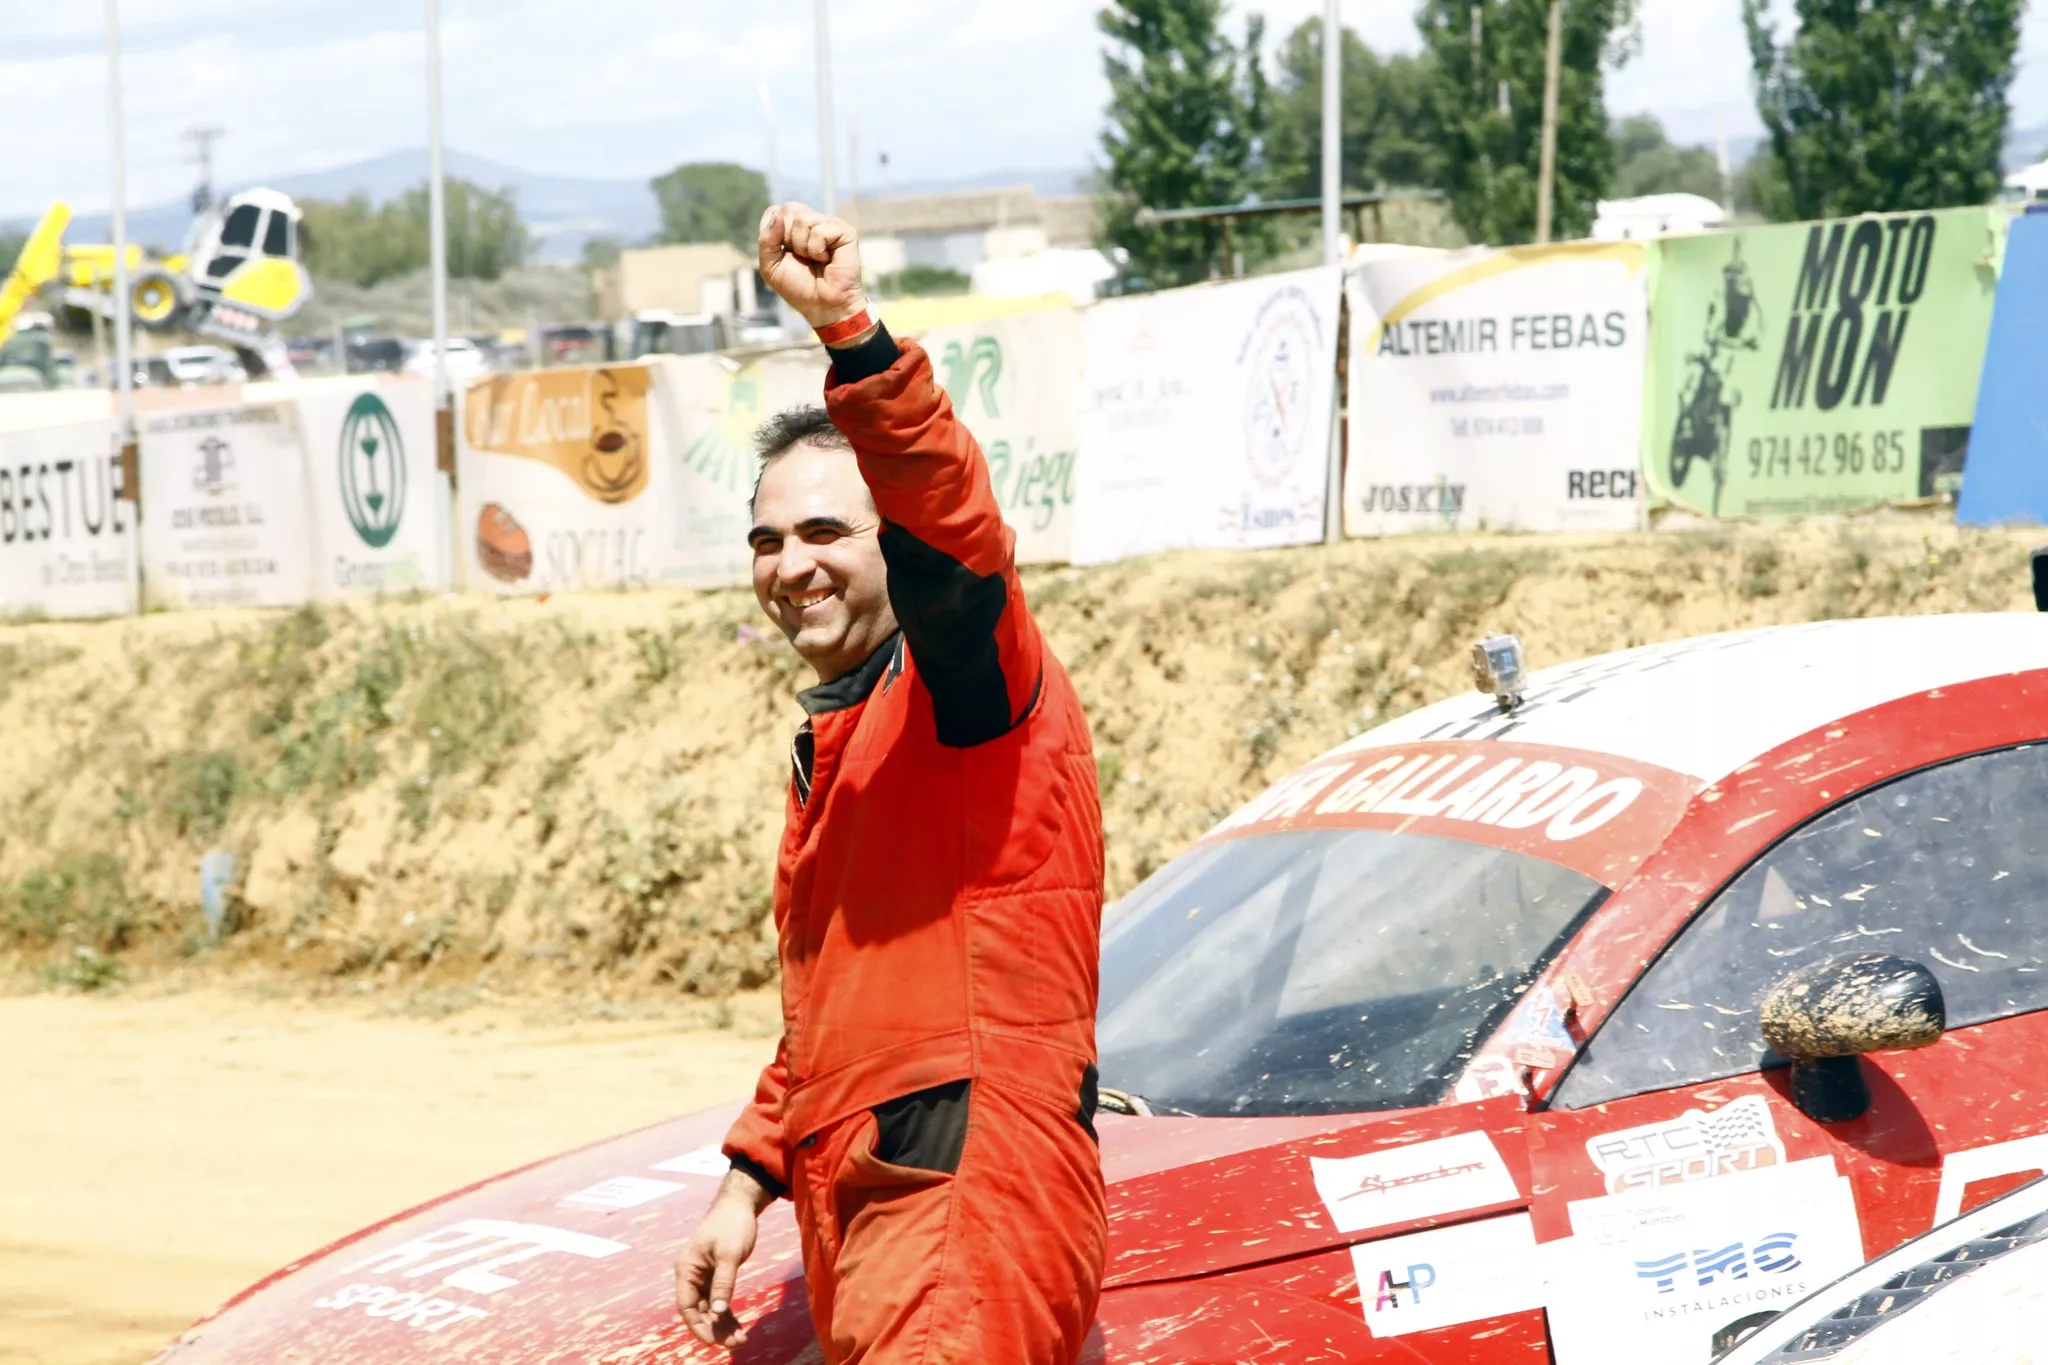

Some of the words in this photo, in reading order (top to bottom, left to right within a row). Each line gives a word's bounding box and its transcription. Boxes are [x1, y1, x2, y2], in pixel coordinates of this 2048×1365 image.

[1793, 213, 1936, 313] MOTO
[1379, 317, 1497, 356] ALTEMIR
[1511, 311, 1626, 351] FEBAS
[1770, 304, 1912, 411] MON
[1748, 436, 1791, 477] 974
[1798, 434, 1827, 475] 42
[1834, 432, 1864, 474] 96
[1871, 430, 1904, 473] 85
[1314, 754, 1644, 841] GALLARDO
[1596, 1126, 1699, 1164] RTC
[1624, 1142, 1770, 1190] SPORT
[315, 1283, 491, 1332] SPORT
[1644, 1281, 1807, 1320] INSTALACIONES
